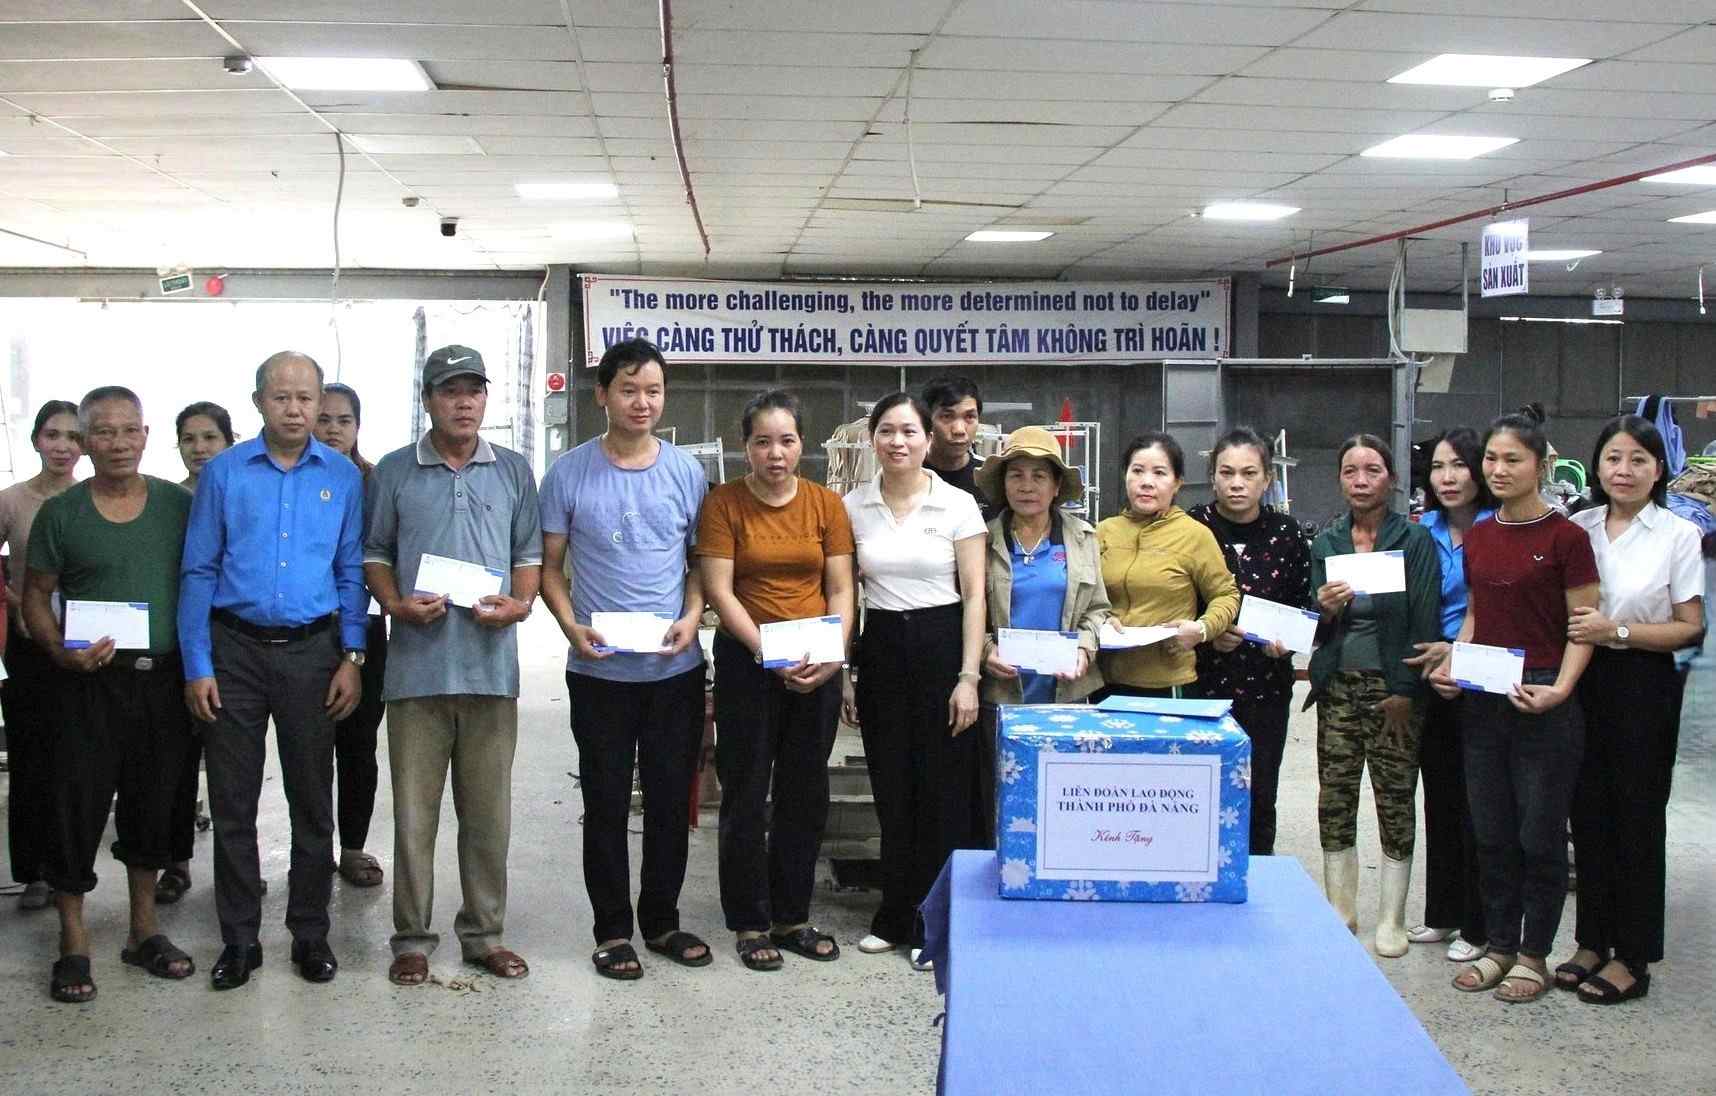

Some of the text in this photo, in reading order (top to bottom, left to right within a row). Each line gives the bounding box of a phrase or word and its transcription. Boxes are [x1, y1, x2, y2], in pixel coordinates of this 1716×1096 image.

[1501, 259, 1524, 289] XUẤT
[610, 289, 1210, 313] "The more challenging, the more determined not to delay"
[656, 322, 714, 352] CÀNG
[721, 320, 763, 353] THỬ
[768, 323, 843, 356] THÁCH,
[850, 323, 907, 353] CÀNG
[914, 321, 979, 355] QUYẾT
[985, 321, 1029, 353] TÂM
[1037, 323, 1107, 353] KHÔNG
[1114, 323, 1144, 351] TRÌ
[1152, 323, 1206, 351] HOÃN
[1214, 327, 1220, 351] !
[1094, 786, 1128, 798] ĐOÀN
[1131, 788, 1156, 798] LAO
[1160, 787, 1195, 800] ĐỘNG
[1059, 799, 1104, 812] THÀNH
[1108, 800, 1136, 812] PHỐ
